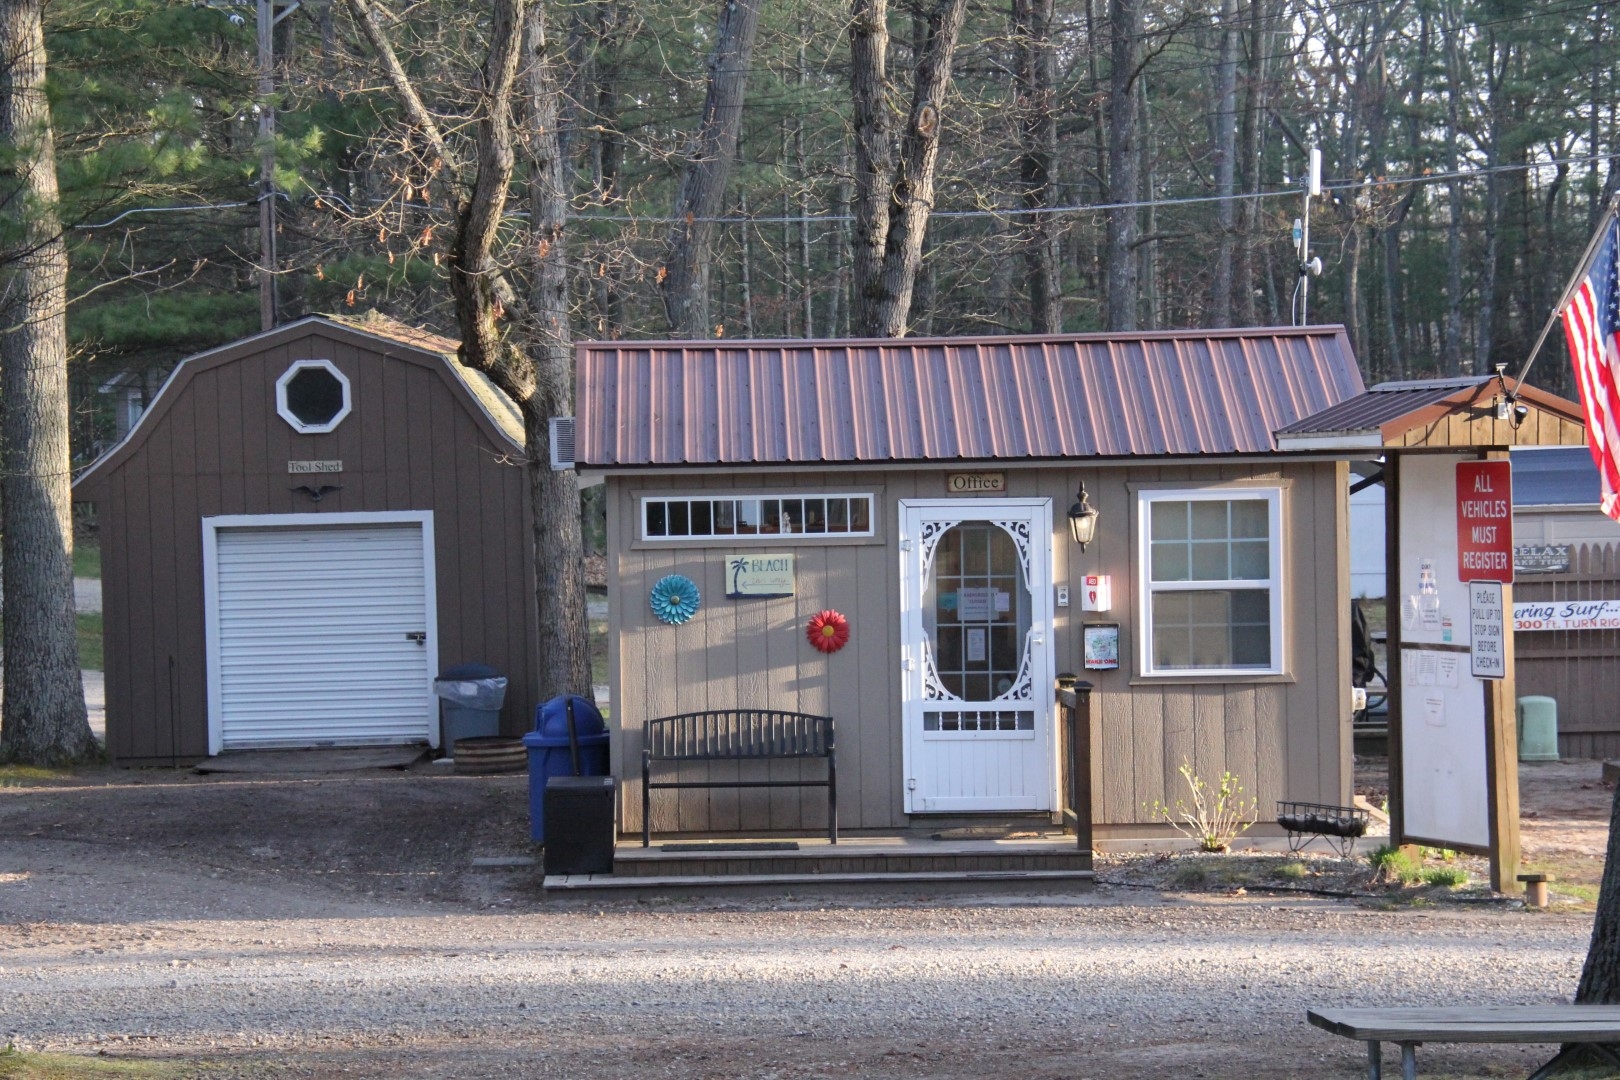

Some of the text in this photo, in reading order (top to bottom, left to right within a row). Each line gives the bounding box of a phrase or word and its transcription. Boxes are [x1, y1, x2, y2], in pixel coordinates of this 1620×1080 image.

[289, 462, 340, 472] Tool Shed
[954, 475, 998, 489] Office
[1474, 474, 1493, 492] ALL
[1461, 500, 1507, 518] VEHICLES
[1472, 526, 1496, 544] MUST
[1463, 552, 1508, 570] REGISTER
[1477, 592, 1496, 604] PLEASE
[1472, 608, 1500, 620] PULL UP TO
[1474, 624, 1500, 636] STOP SIGN
[1515, 620, 1542, 629] 300
[1546, 620, 1560, 628] ft.
[1565, 620, 1597, 628] TURN
[1478, 640, 1496, 652] BEFORE
[1476, 656, 1500, 668] CHECK-IN
